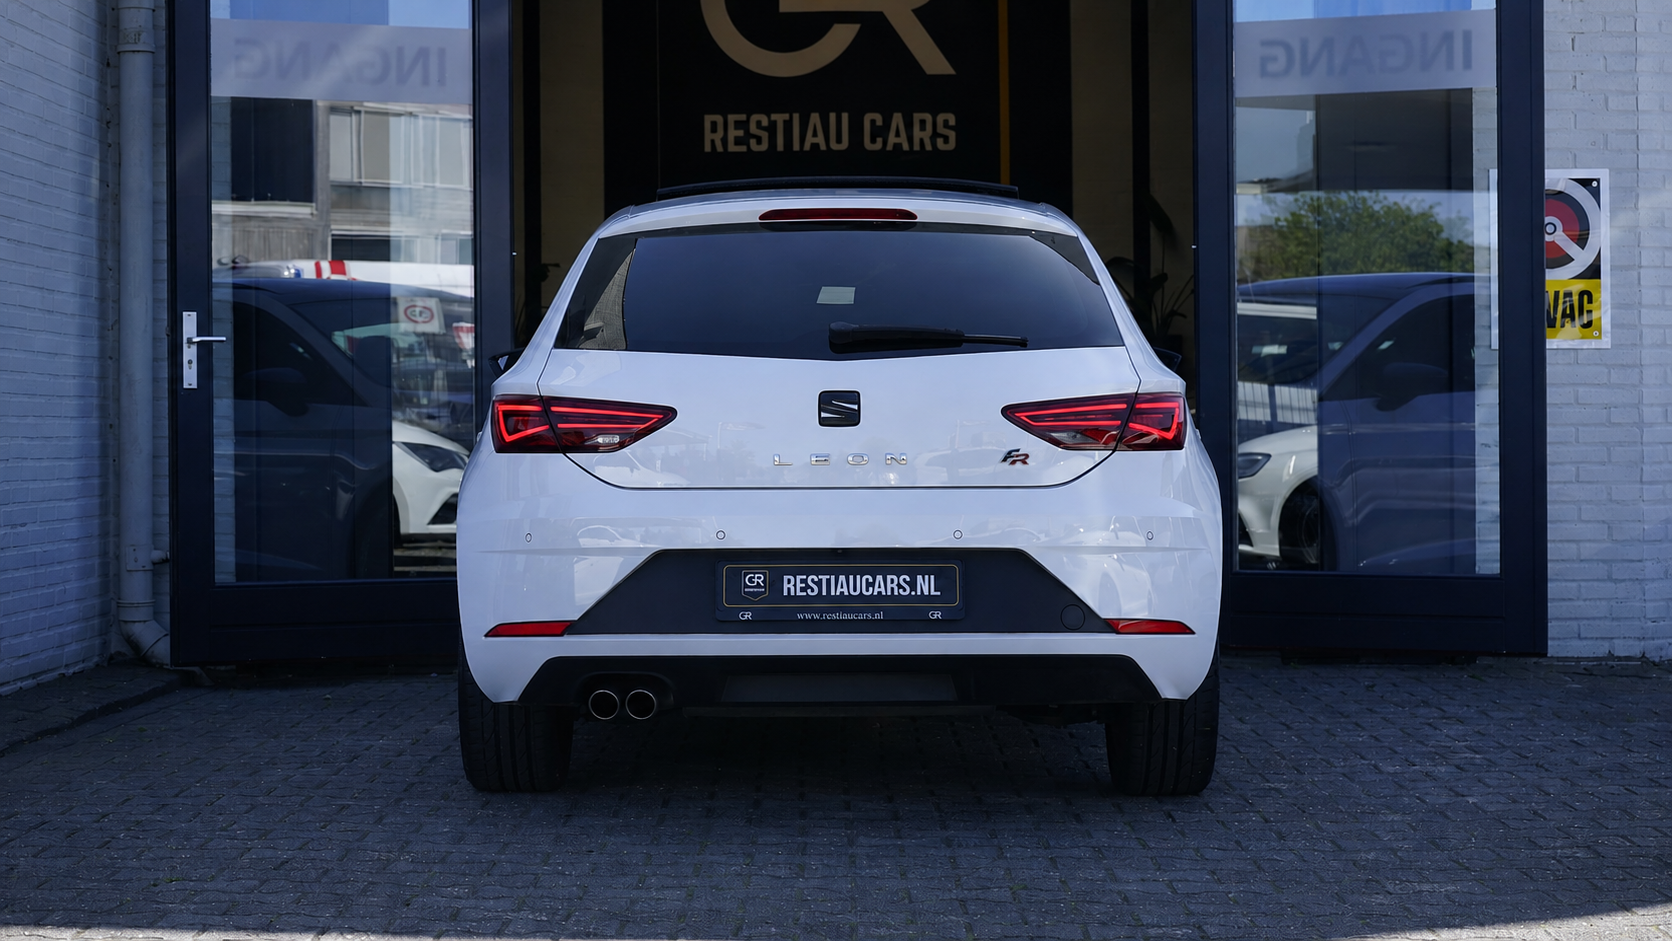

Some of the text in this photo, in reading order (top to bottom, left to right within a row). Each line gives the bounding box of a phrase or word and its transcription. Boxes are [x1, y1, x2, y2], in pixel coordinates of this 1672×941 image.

[703, 112, 957, 153] RESTIAU CARS
[773, 453, 908, 467] LEON
[783, 574, 941, 596] RESTIAUCARS.NL
[796, 611, 884, 620] www.restiaucars.nl
